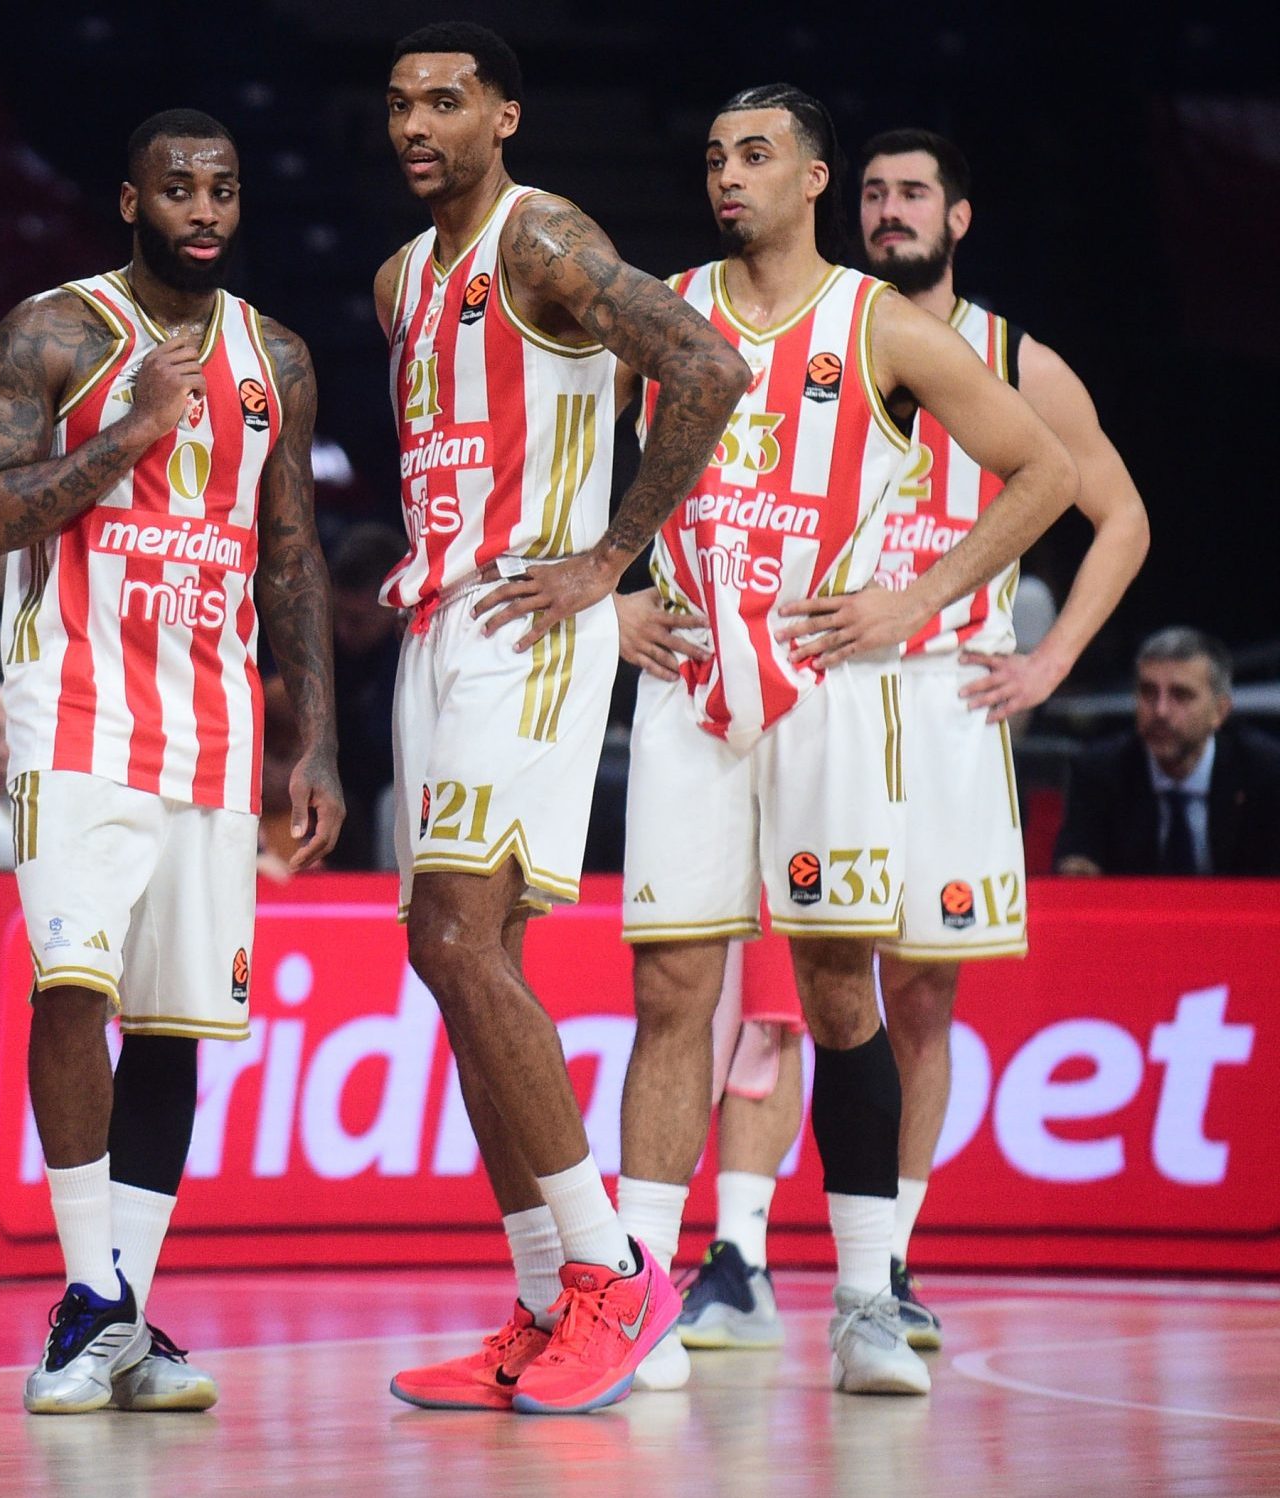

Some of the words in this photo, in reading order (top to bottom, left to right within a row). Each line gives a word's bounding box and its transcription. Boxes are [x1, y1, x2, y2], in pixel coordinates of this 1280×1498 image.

[405, 352, 443, 423] 21
[166, 440, 212, 500] 0
[400, 431, 485, 479] eridian
[708, 412, 786, 475] 33
[896, 442, 934, 500] 2
[685, 489, 820, 535] meridian
[99, 521, 242, 568] meridian
[697, 541, 783, 594] mts
[121, 577, 226, 628] mts
[430, 781, 493, 844] 21
[828, 848, 890, 906] 33
[981, 871, 1021, 927] 12
